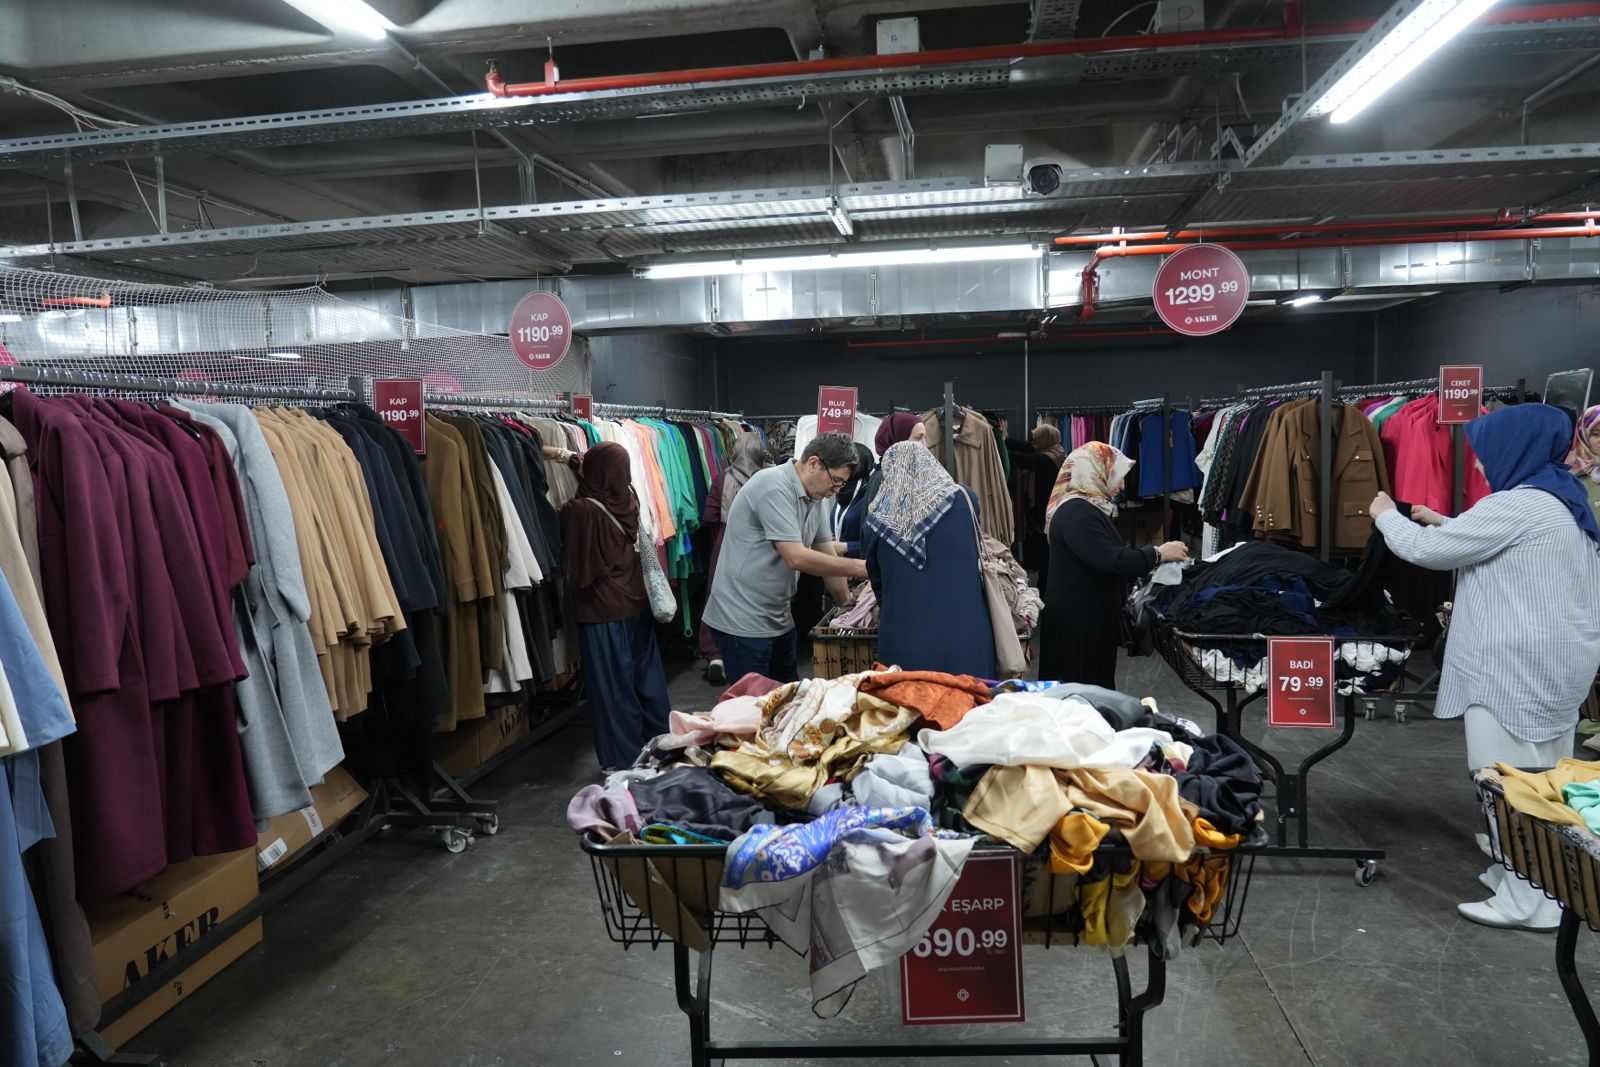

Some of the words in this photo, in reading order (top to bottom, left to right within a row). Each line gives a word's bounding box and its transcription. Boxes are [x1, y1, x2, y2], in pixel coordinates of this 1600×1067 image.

[1180, 267, 1220, 281] MONT
[531, 313, 549, 322] KAP
[1194, 314, 1218, 323] AKER
[518, 325, 563, 342] 1190.99
[1444, 388, 1478, 399] 1190.99
[389, 397, 408, 406] KAP
[379, 409, 419, 422] 1190.99
[821, 407, 852, 418] 749.99
[1289, 658, 1314, 669] BADİ
[951, 898, 1005, 914] EŞARP
[913, 927, 1008, 958] 690.99
[122, 906, 220, 994] AKER
